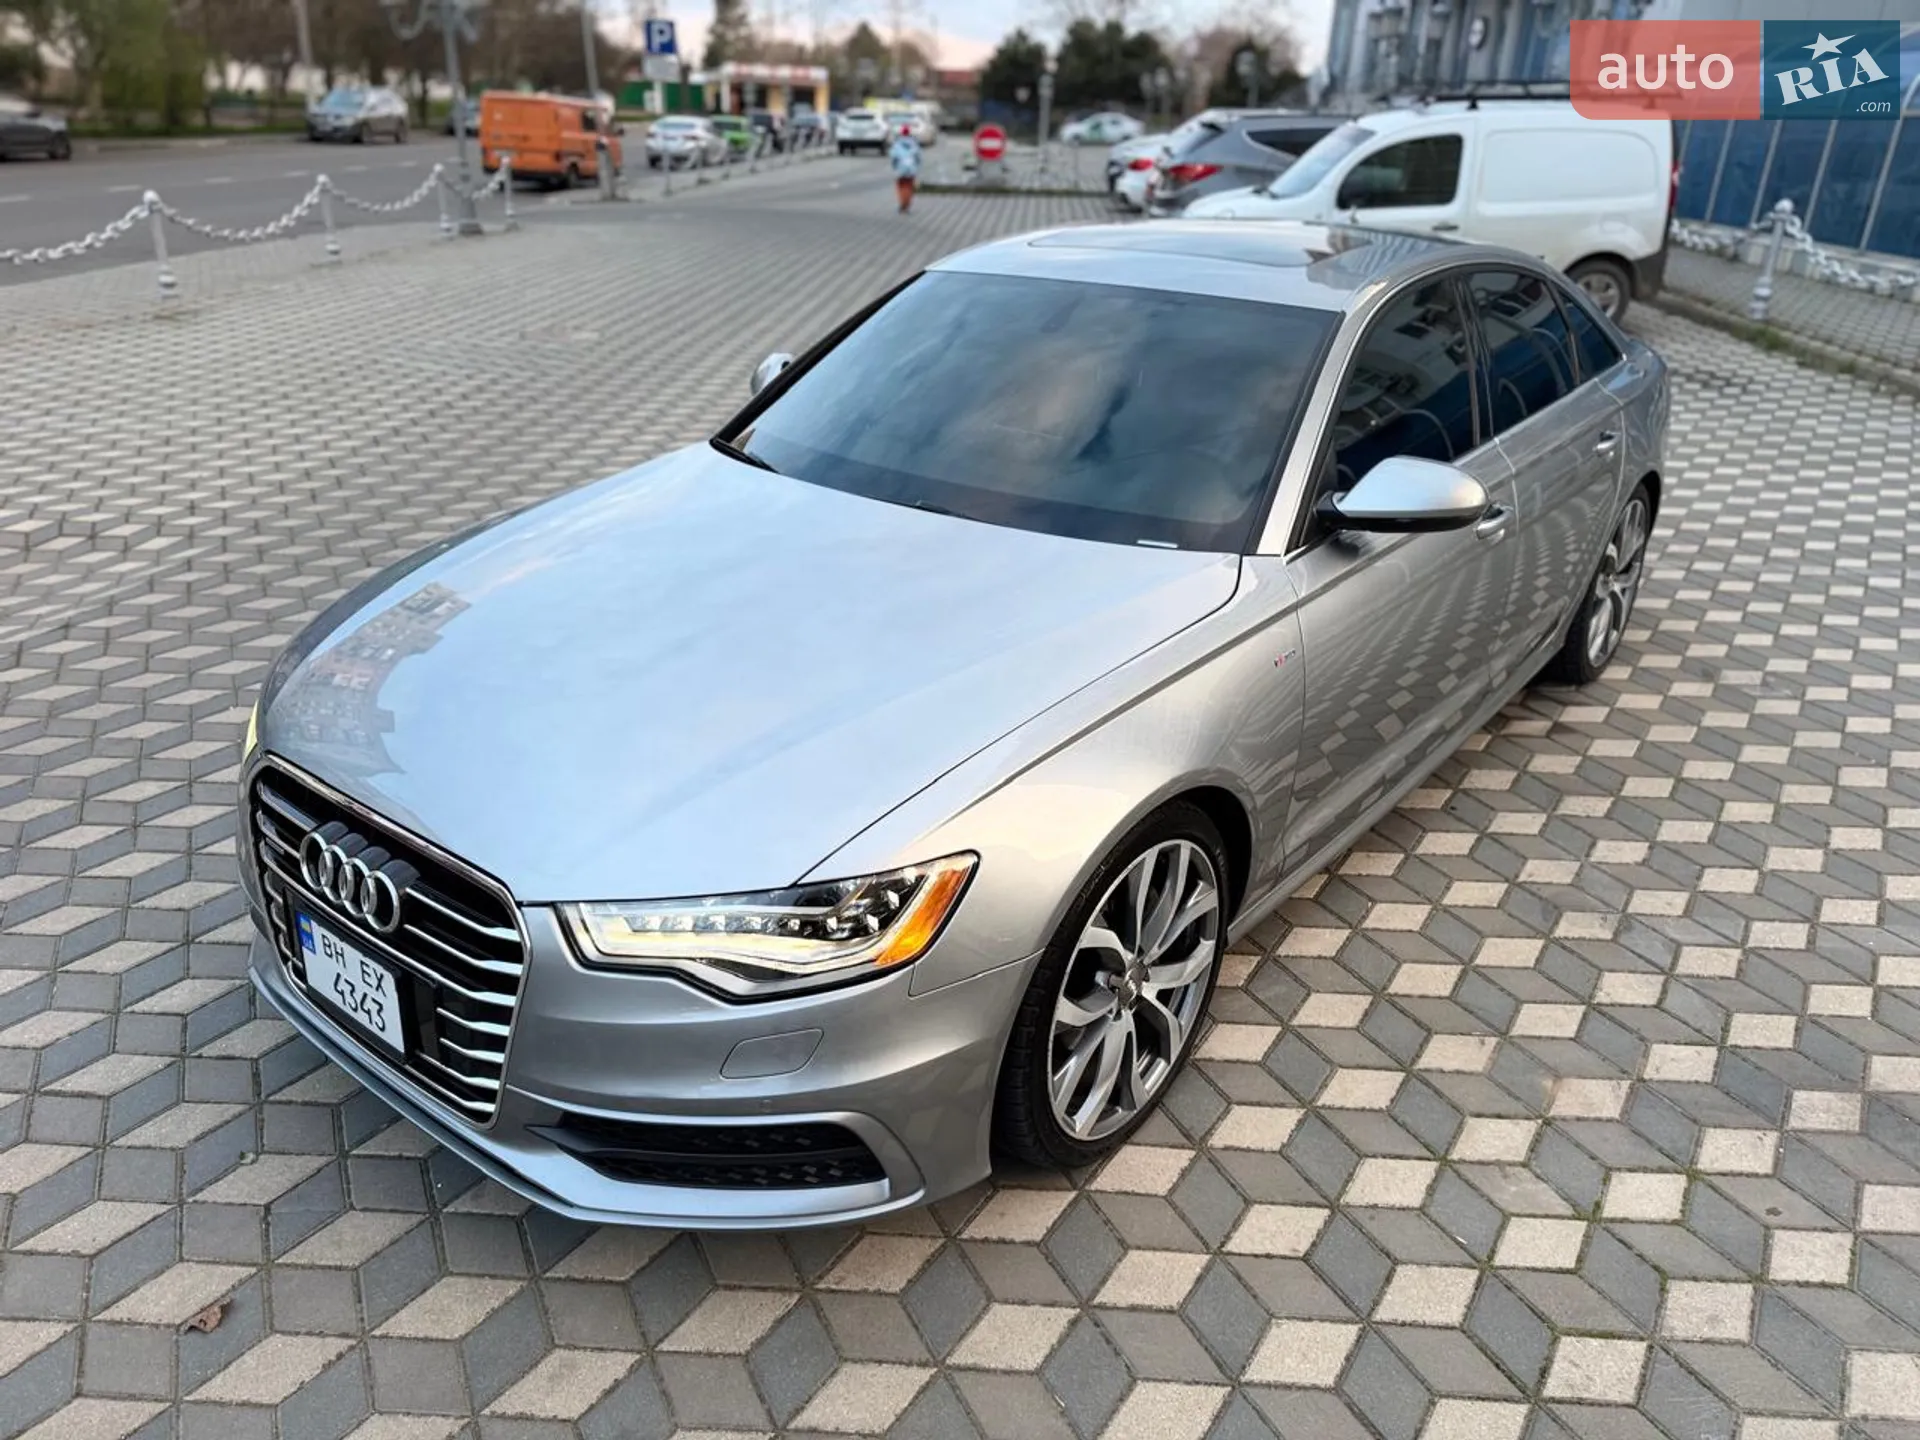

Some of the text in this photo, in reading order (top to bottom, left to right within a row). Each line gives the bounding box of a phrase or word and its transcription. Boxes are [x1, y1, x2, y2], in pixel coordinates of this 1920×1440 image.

[650, 22, 674, 54] P
[321, 933, 387, 998] BH EX
[334, 972, 386, 1032] 4343
